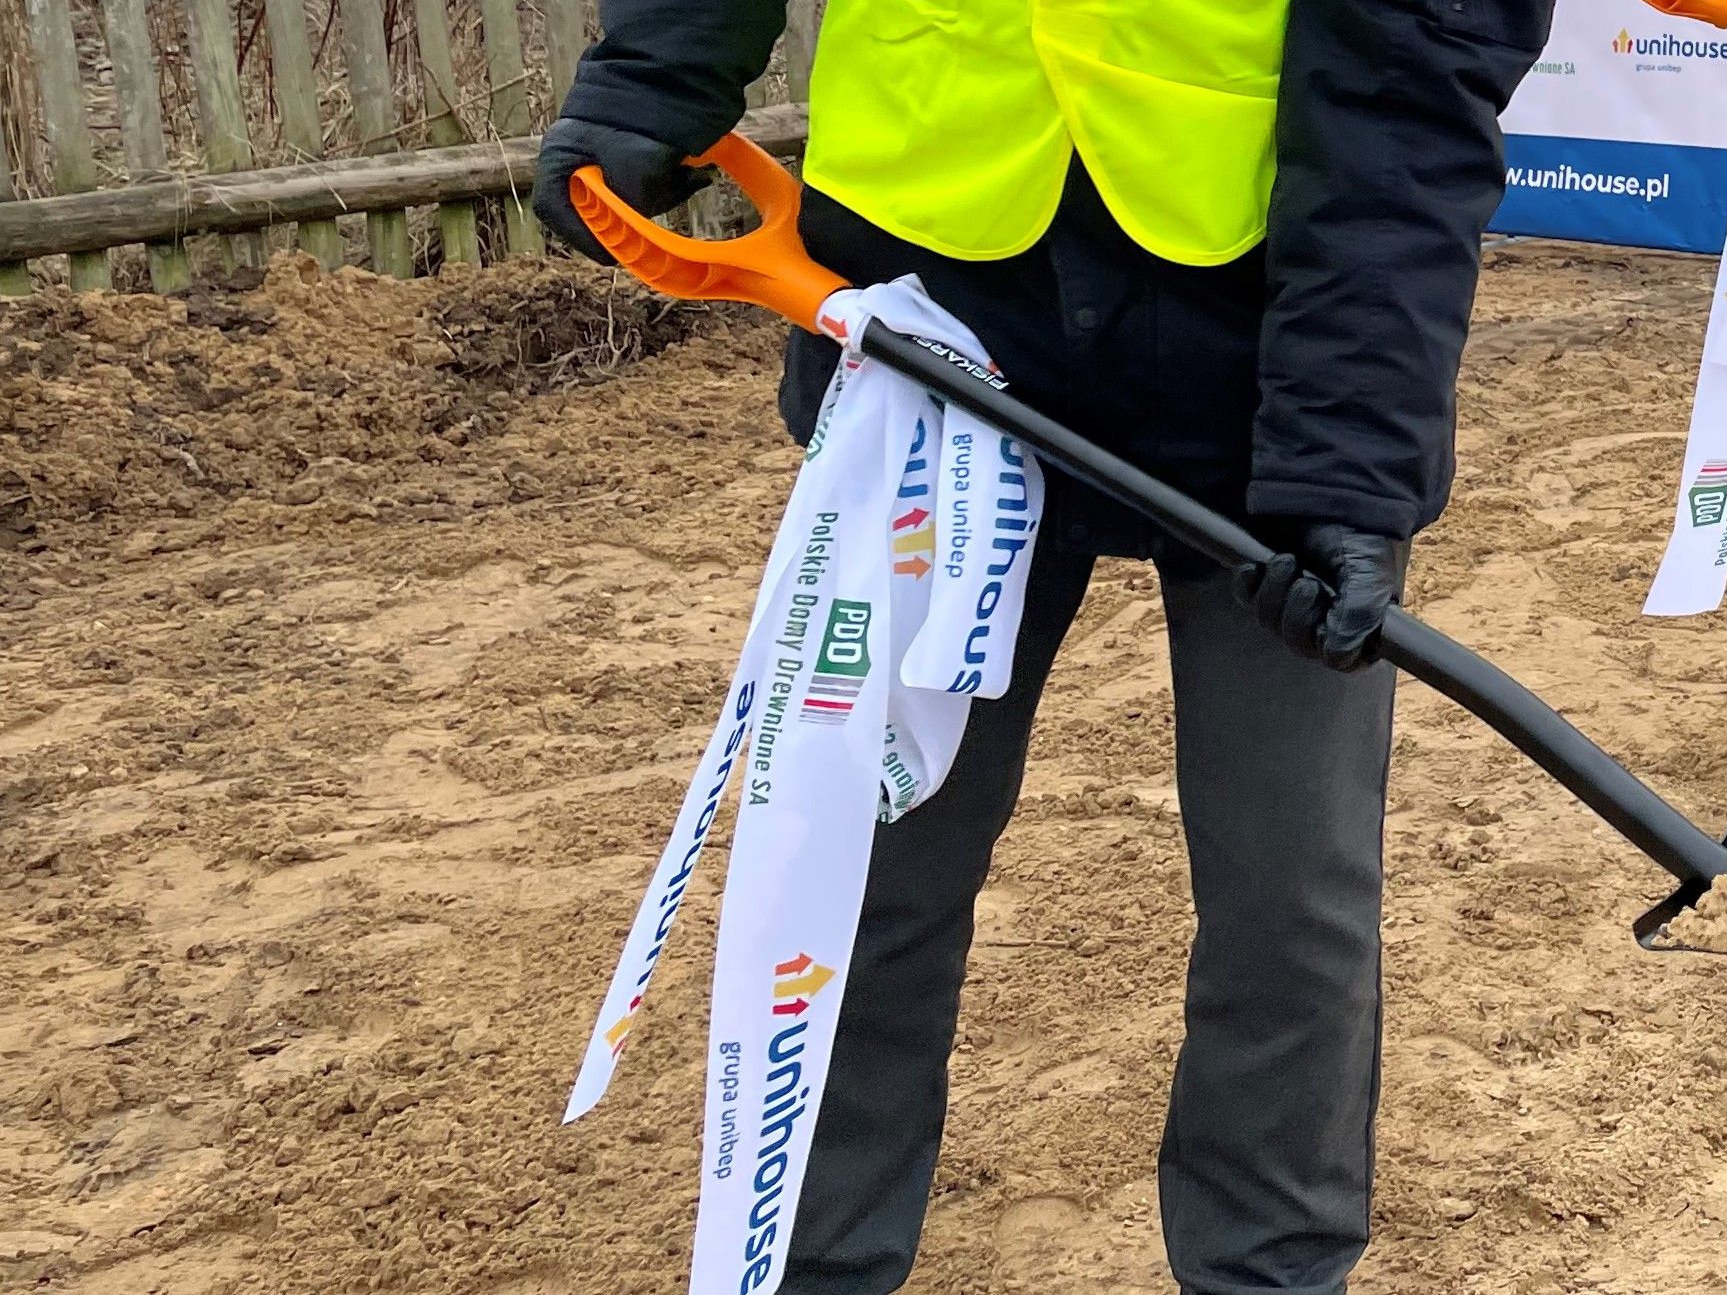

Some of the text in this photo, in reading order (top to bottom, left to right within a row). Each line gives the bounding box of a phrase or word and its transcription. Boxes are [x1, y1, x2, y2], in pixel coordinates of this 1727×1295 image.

[1564, 61, 1576, 75] SA
[1504, 163, 1670, 202] w.unihouse.pl
[944, 433, 973, 579] grupa unibep
[1693, 491, 1725, 525] PDD
[797, 511, 839, 587] Polskie
[944, 436, 1037, 694] unihous
[775, 592, 818, 653] Domy
[826, 607, 868, 665] PDD
[753, 657, 804, 772] Drewniane
[748, 778, 772, 806] SA
[637, 680, 756, 987] unihouse
[712, 1041, 741, 1180] grupa unibep
[740, 1020, 810, 1295] unihouse
